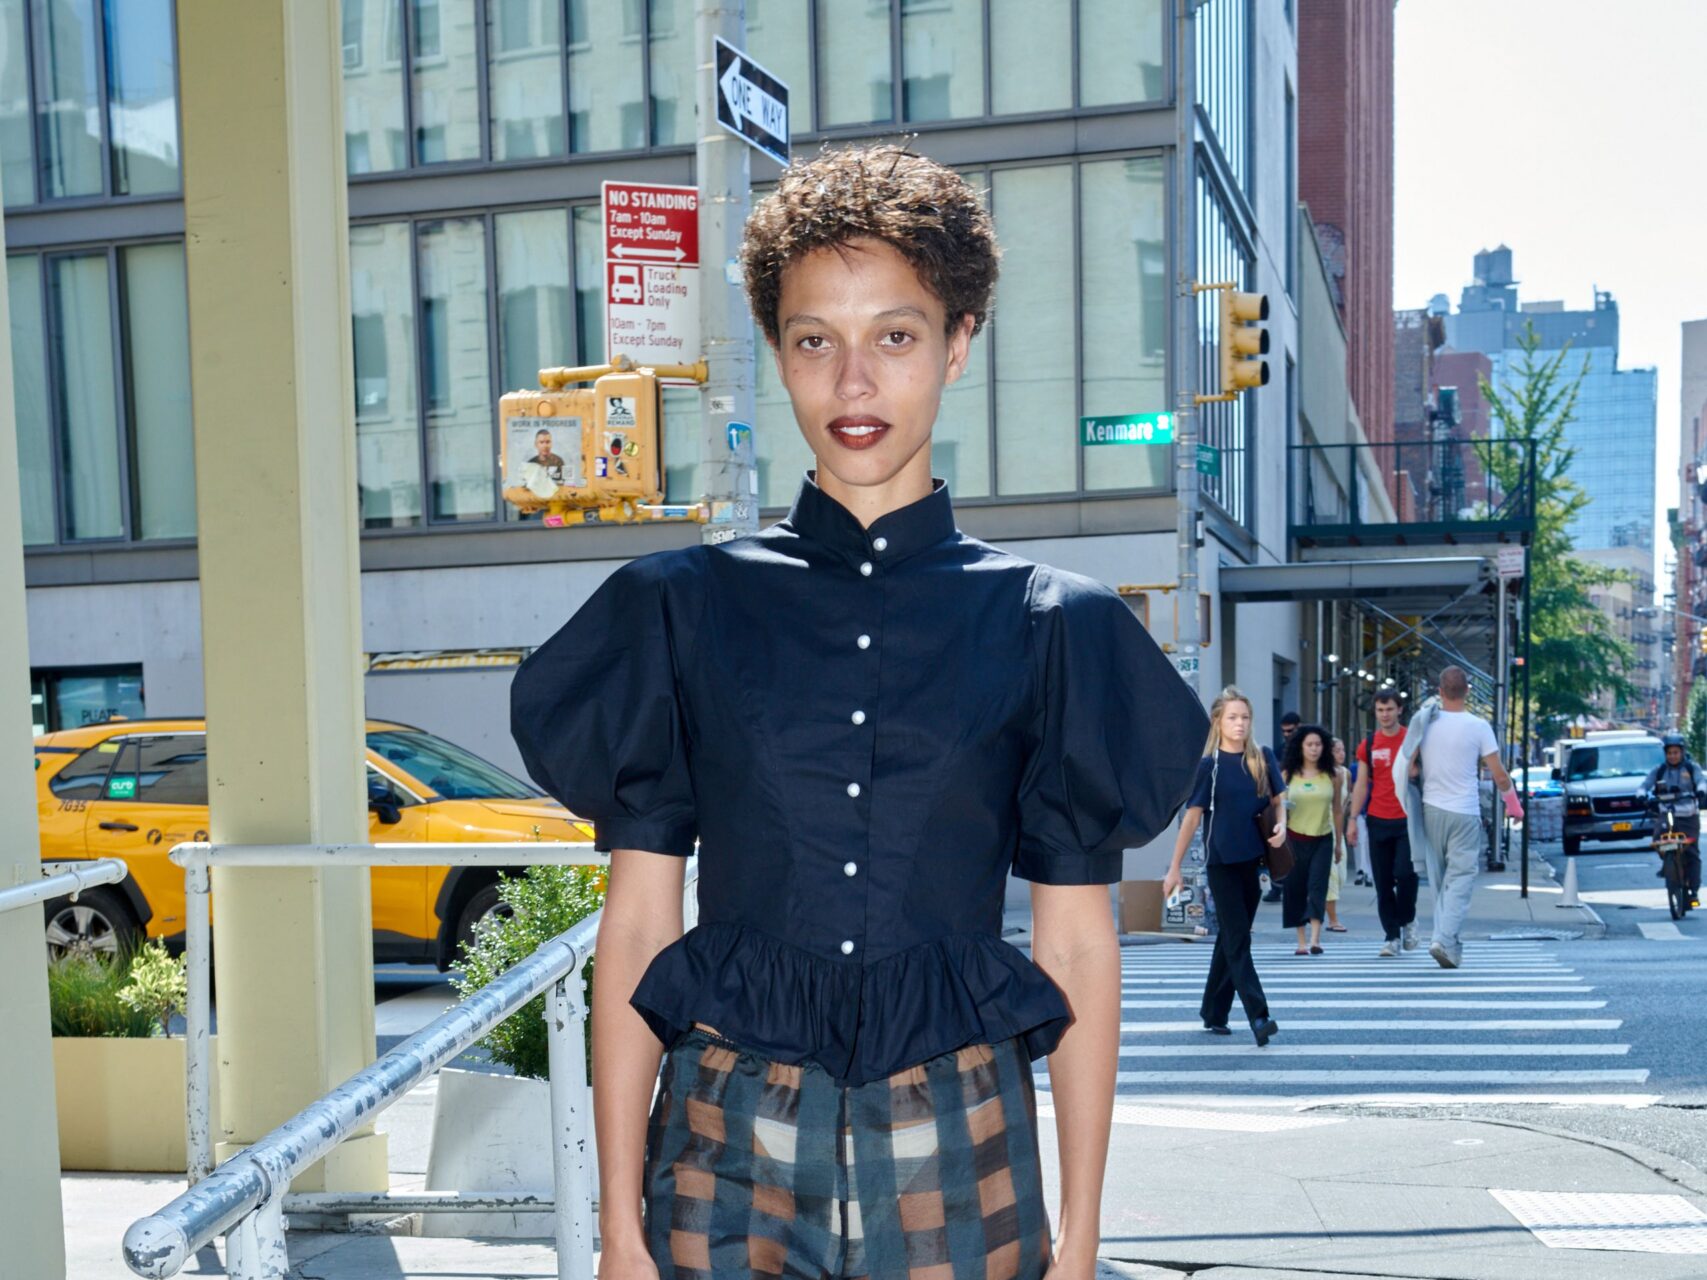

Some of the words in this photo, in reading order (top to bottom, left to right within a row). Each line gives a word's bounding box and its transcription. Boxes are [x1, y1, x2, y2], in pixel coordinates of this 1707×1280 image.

[731, 76, 751, 116] ONE
[761, 94, 782, 135] WAY
[609, 190, 628, 207] NO
[631, 191, 697, 211] STANDING
[609, 210, 632, 223] 7am
[640, 211, 667, 226] 10am
[610, 225, 644, 241] Except
[646, 227, 682, 244] Sunday
[648, 268, 677, 281] Truck
[647, 282, 688, 297] Loading
[648, 295, 671, 310] Only
[610, 318, 635, 330] 10am
[646, 318, 667, 332] 7pm
[612, 333, 646, 347] Except
[648, 334, 683, 349] Sunday
[542, 419, 577, 428] PROGRESS
[1086, 420, 1154, 442] Kenmare
[57, 800, 87, 813] 7035
